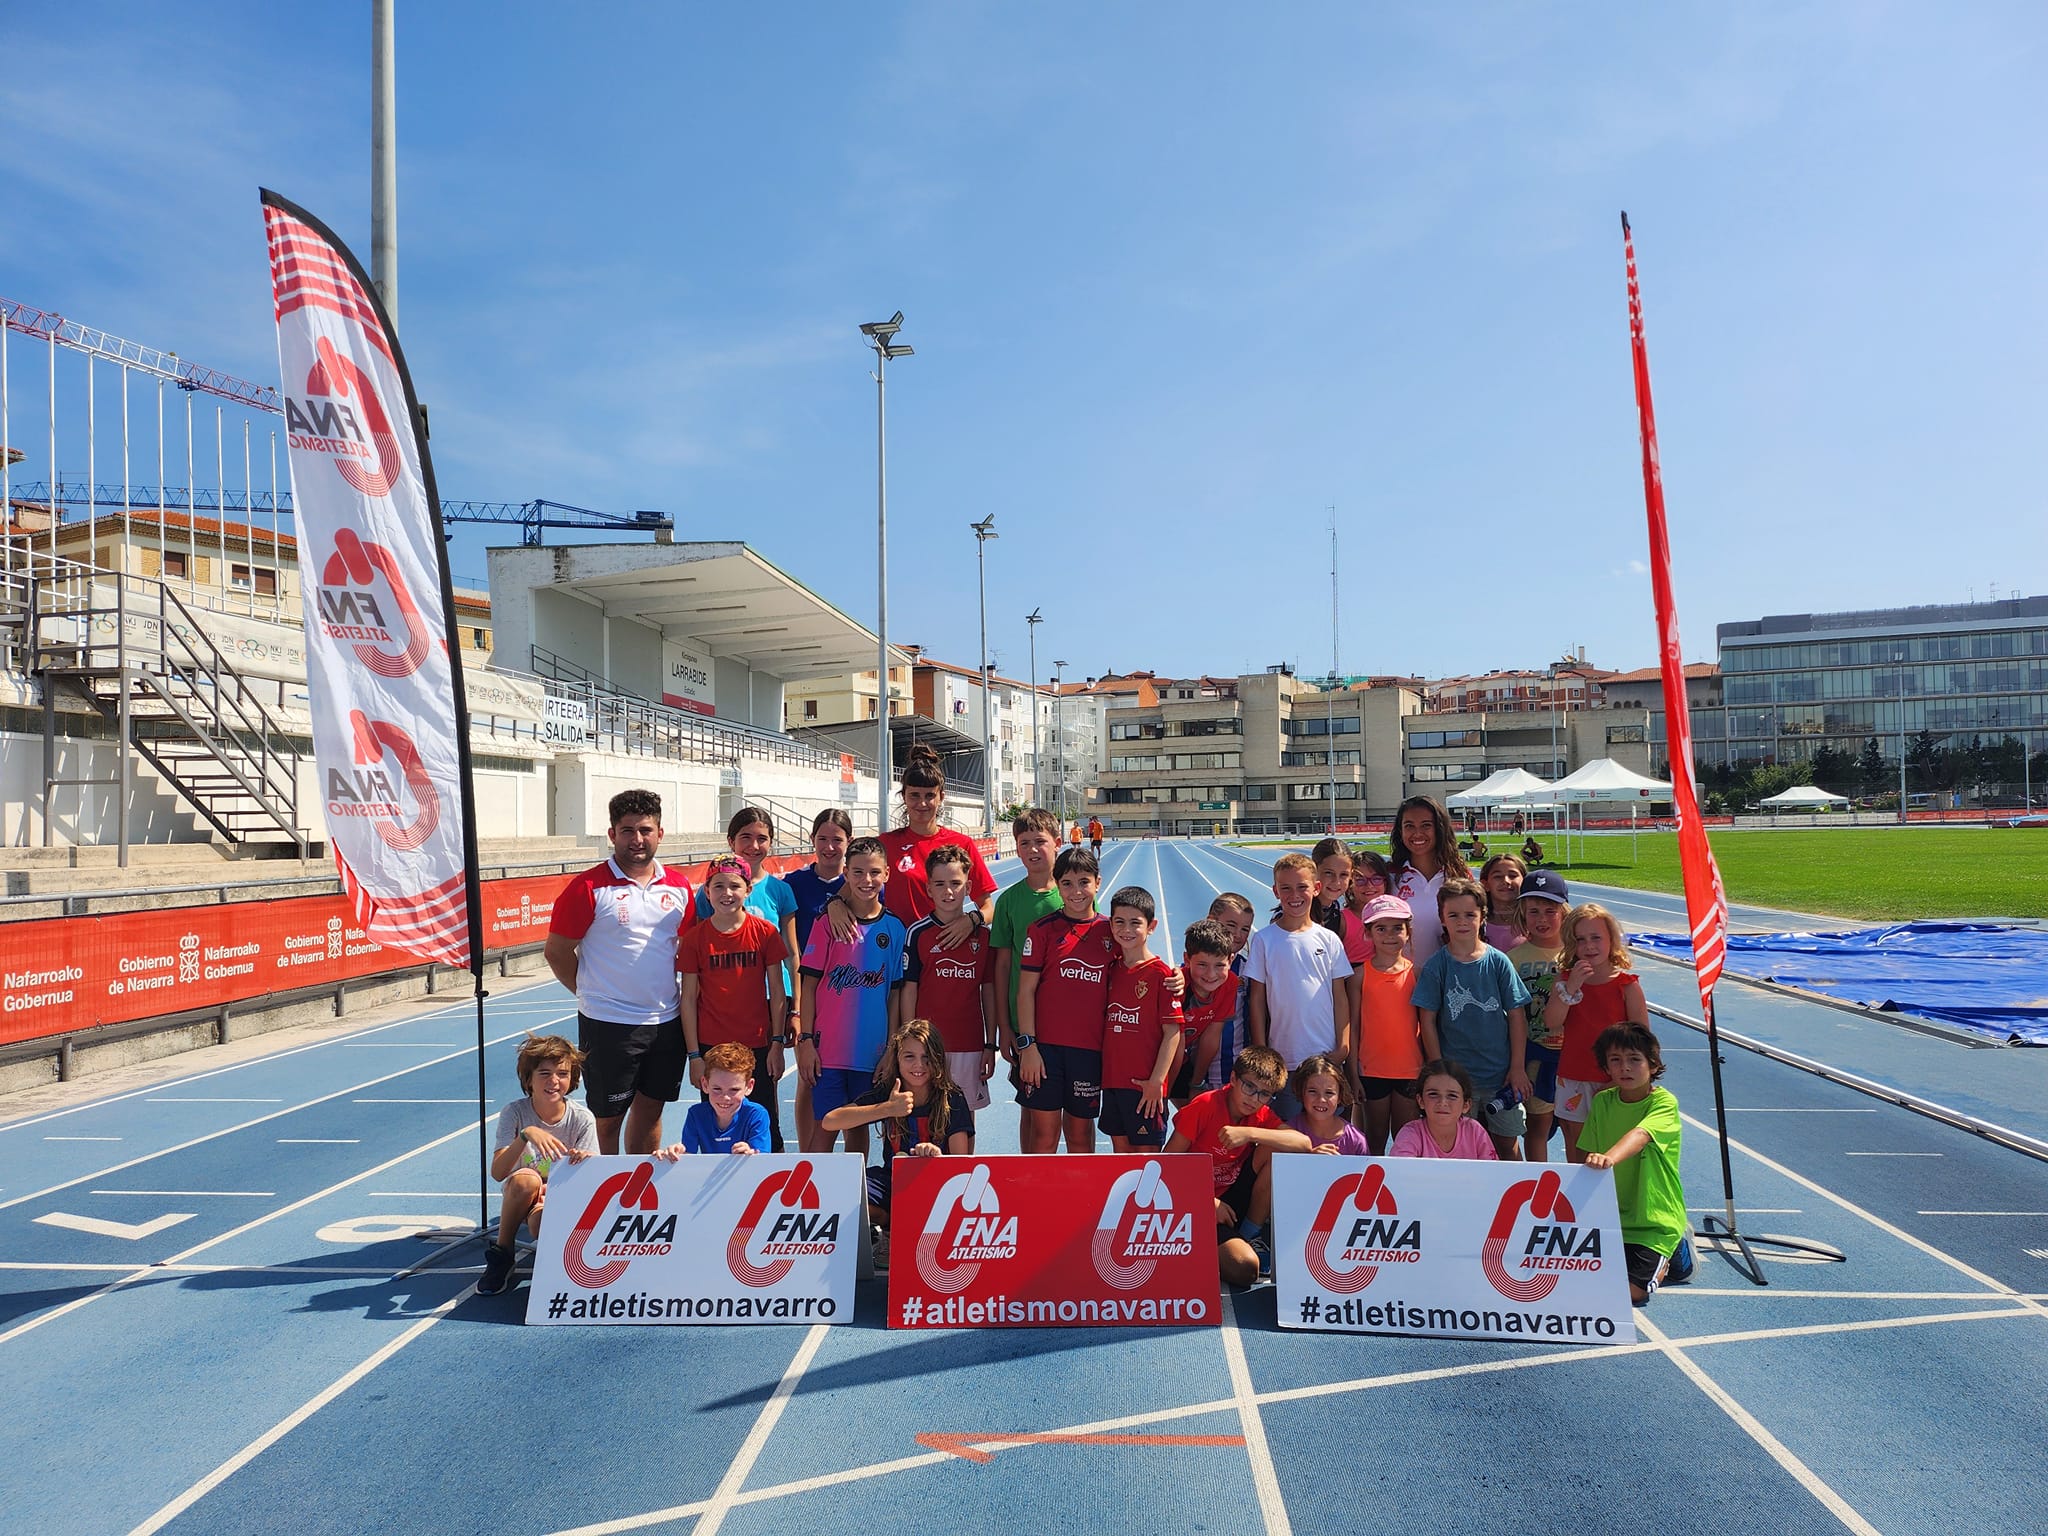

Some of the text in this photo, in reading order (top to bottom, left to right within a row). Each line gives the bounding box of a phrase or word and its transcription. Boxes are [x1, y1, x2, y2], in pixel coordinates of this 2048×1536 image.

[671, 662, 707, 686] LARRABIDE
[545, 699, 584, 721] IRTEERA
[545, 721, 584, 744] SALIDA
[496, 907, 520, 918] Gobierno
[345, 928, 365, 940] Nafa
[492, 920, 520, 931] de Navarra
[284, 934, 325, 949] Gobierno
[204, 942, 260, 961] Nafarroako
[277, 951, 325, 967] de Navarra
[119, 955, 174, 973] Gobierno
[204, 962, 254, 980] Gobernua
[936, 967, 976, 979] verleal
[3, 965, 83, 990] Nafarroako
[828, 963, 886, 996] Miami
[1059, 967, 1102, 983] verleal
[108, 975, 174, 995] de Navarra
[3, 990, 74, 1012] Gobernua
[605, 1214, 678, 1243] FNA
[767, 1213, 840, 1242] FNA
[952, 1216, 1018, 1246] FNA
[1127, 1213, 1193, 1243] FNA
[1345, 1218, 1422, 1250] FNA
[597, 1243, 672, 1257] ATLETISMO
[760, 1243, 836, 1256] ATLETISMO
[1122, 1243, 1192, 1256] ATLETISMO
[1523, 1225, 1602, 1258] FNA
[947, 1245, 1017, 1260] ATLETISMO
[1340, 1248, 1421, 1264] ATLETISMO
[1519, 1256, 1602, 1272] ATLETISMO
[548, 1292, 836, 1319] #atletismonavarro
[902, 1295, 1207, 1325] #atletismonavarro
[1300, 1295, 1616, 1338] #atletismonavarro
